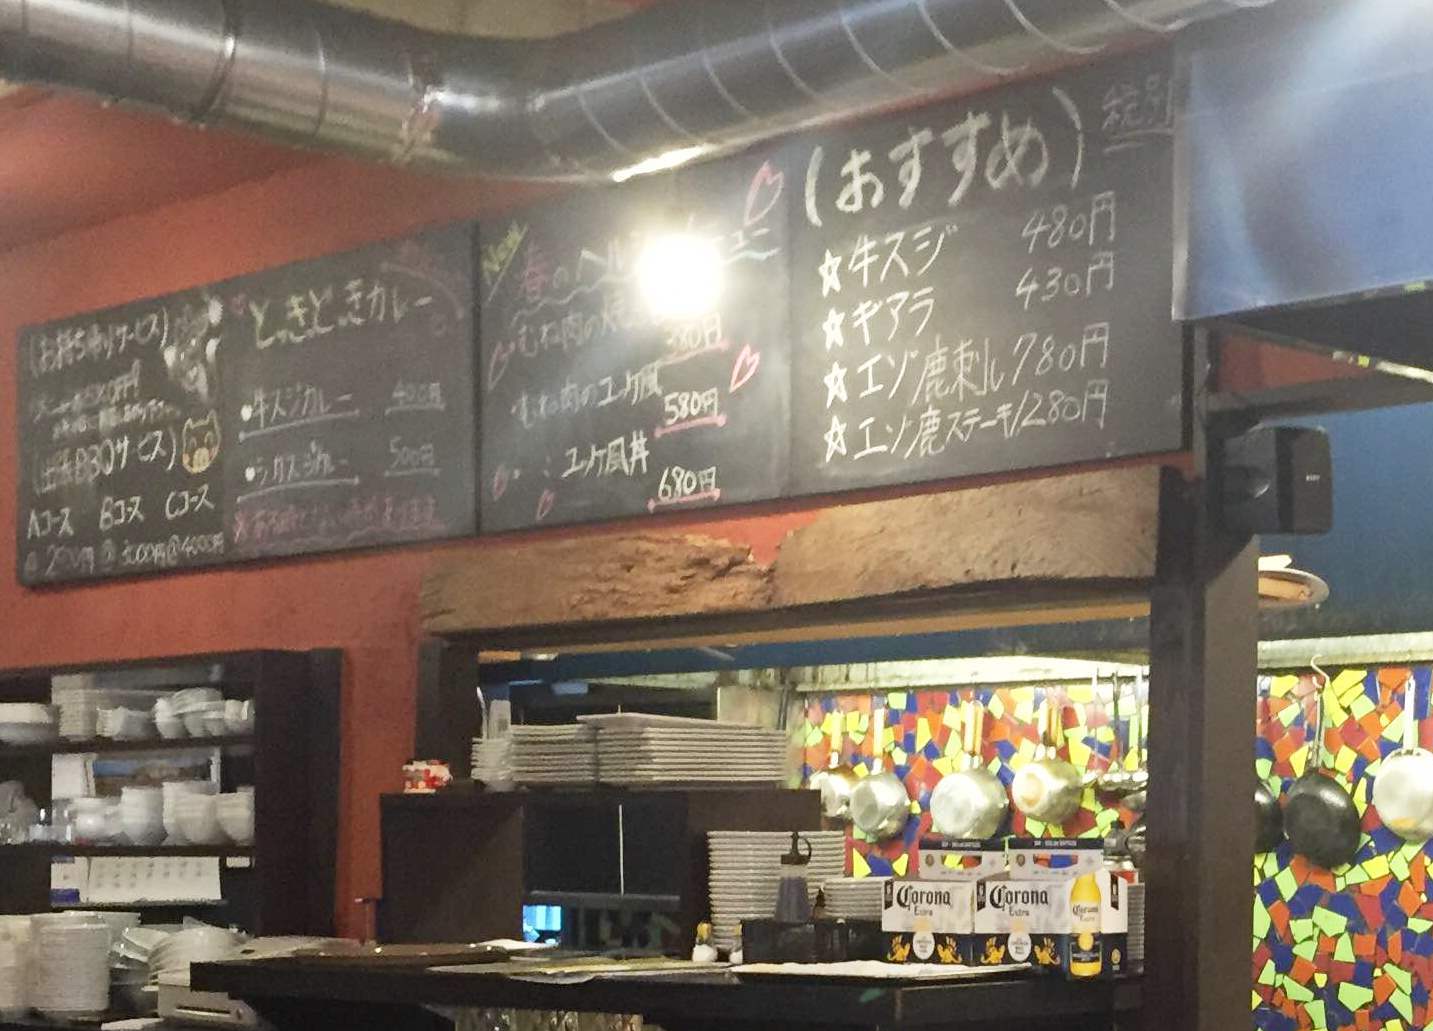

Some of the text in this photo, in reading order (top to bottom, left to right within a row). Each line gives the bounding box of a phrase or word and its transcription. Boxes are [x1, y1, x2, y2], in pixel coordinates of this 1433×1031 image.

[1022, 191, 1116, 254] 480円
[1016, 251, 1114, 310] 430円
[1012, 322, 1110, 386] 780円
[663, 387, 718, 426] 580円
[1011, 379, 1110, 437] 1280円
[657, 466, 717, 502] 680円
[896, 884, 951, 911] Corona
[989, 884, 1049, 911] Corona
